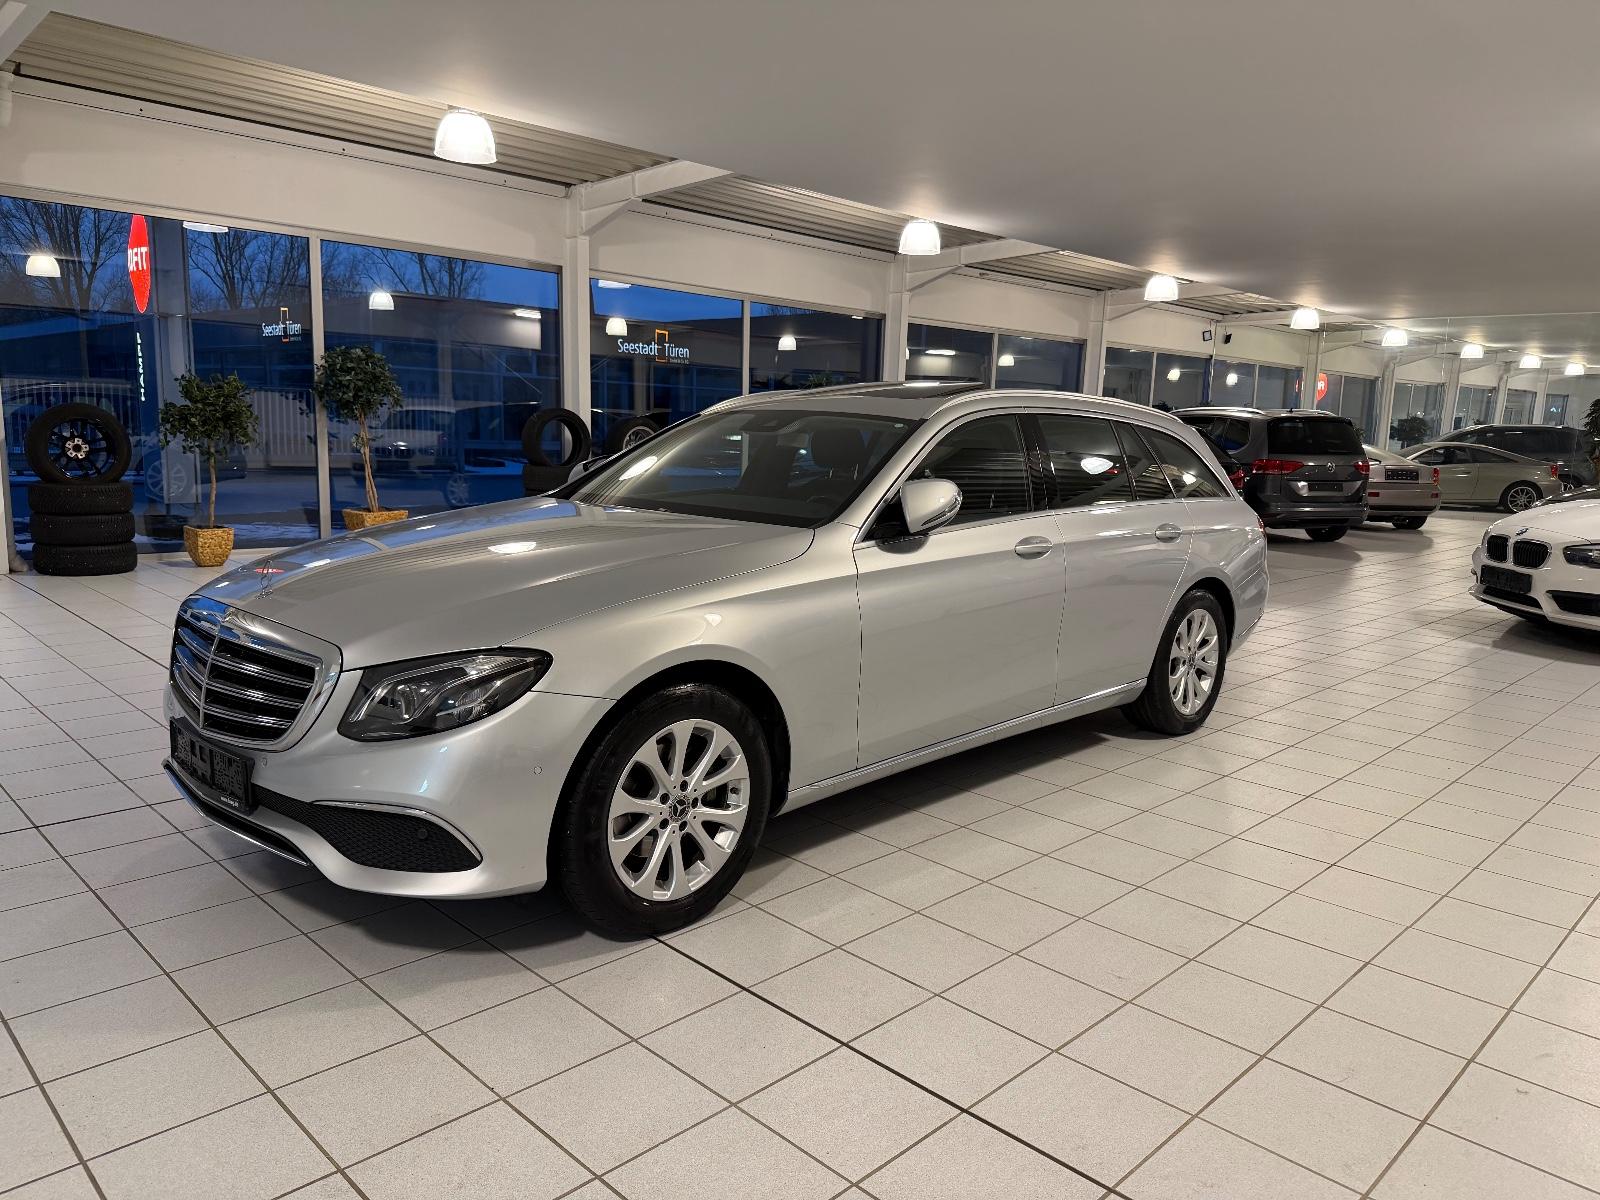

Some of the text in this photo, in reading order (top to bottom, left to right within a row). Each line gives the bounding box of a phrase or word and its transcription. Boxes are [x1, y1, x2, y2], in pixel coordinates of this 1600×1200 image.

[261, 321, 285, 337] Seestadt
[617, 338, 690, 358] Seestadt Türen
